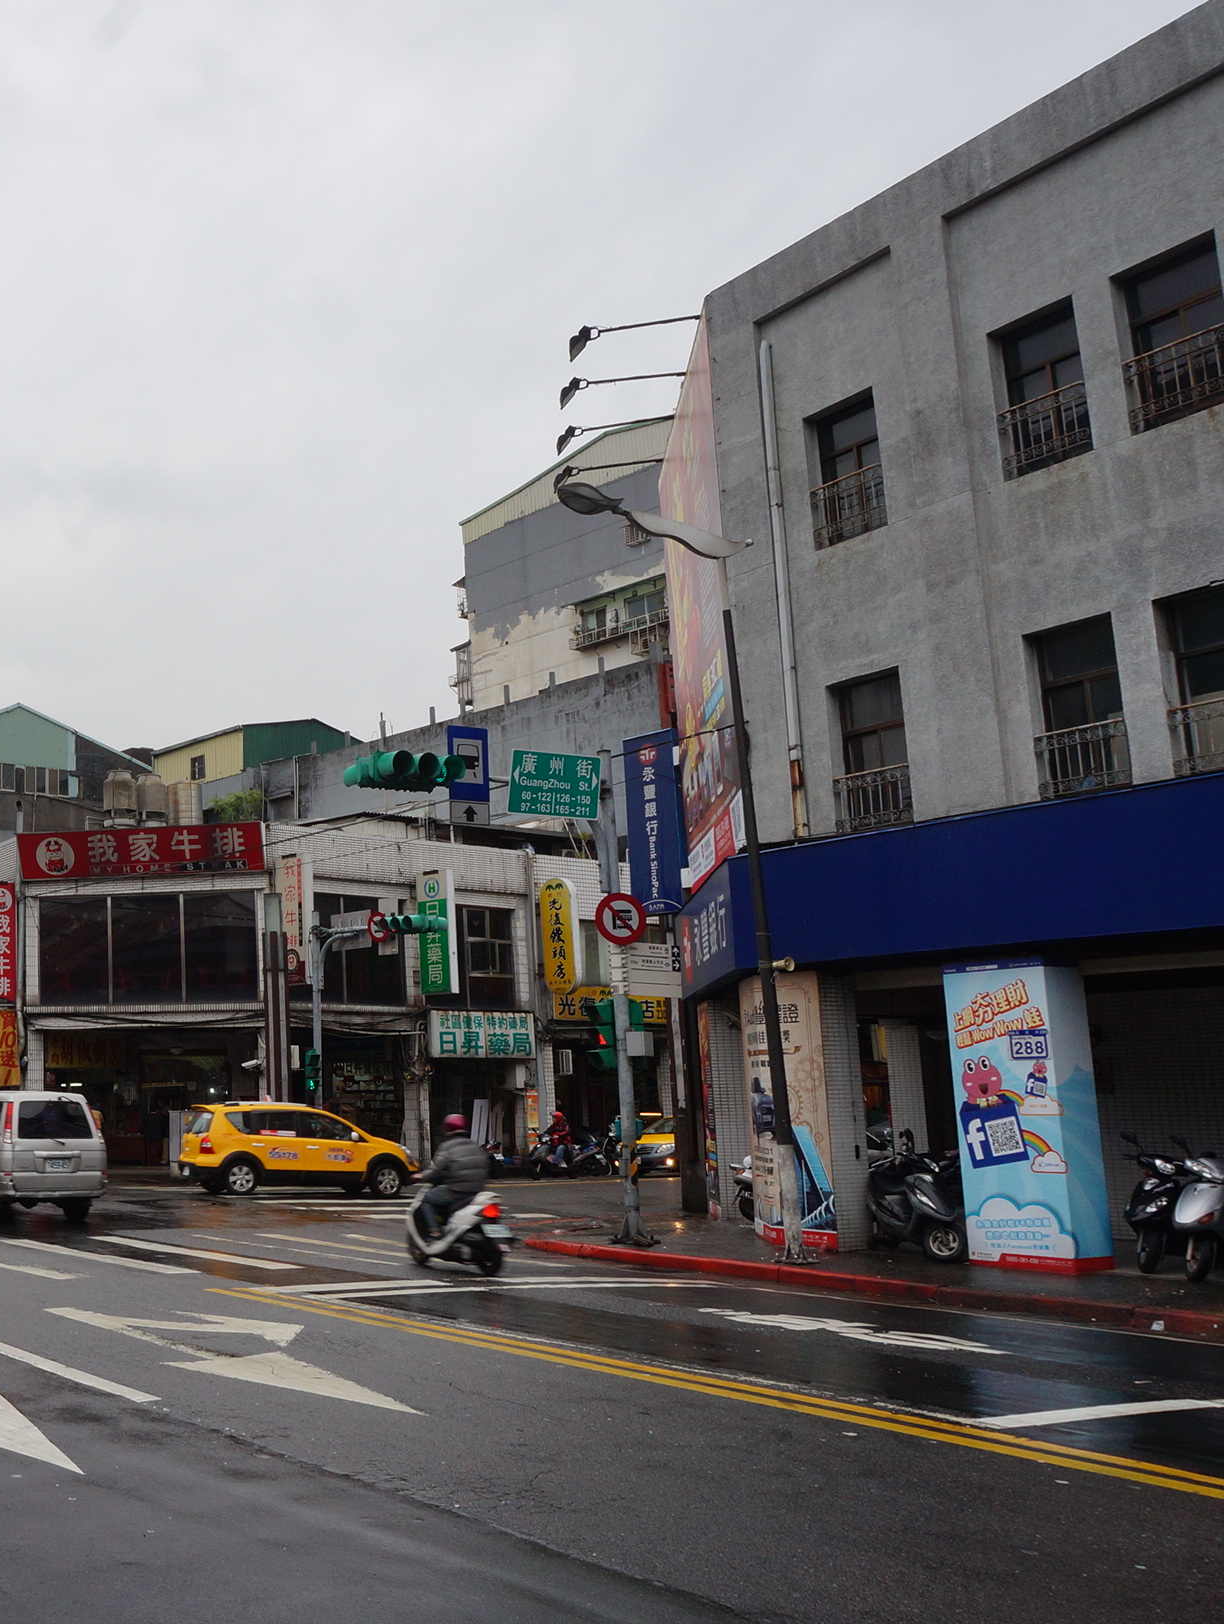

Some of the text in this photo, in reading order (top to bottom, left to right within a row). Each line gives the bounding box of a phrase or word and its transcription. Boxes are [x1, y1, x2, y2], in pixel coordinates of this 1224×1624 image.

[521, 753, 593, 778] 廣州街
[520, 776, 590, 791] GuangZhou St.
[522, 791, 591, 804] 60-122 126-150
[643, 767, 658, 836] 永豐銀行
[520, 803, 590, 815] 97-163 165-211
[87, 827, 246, 863] 我家牛排
[123, 862, 171, 874] HOME
[649, 836, 659, 898] Bank SinoPac
[440, 1031, 532, 1056] 日昇藥局
[1014, 1041, 1044, 1055] 288
